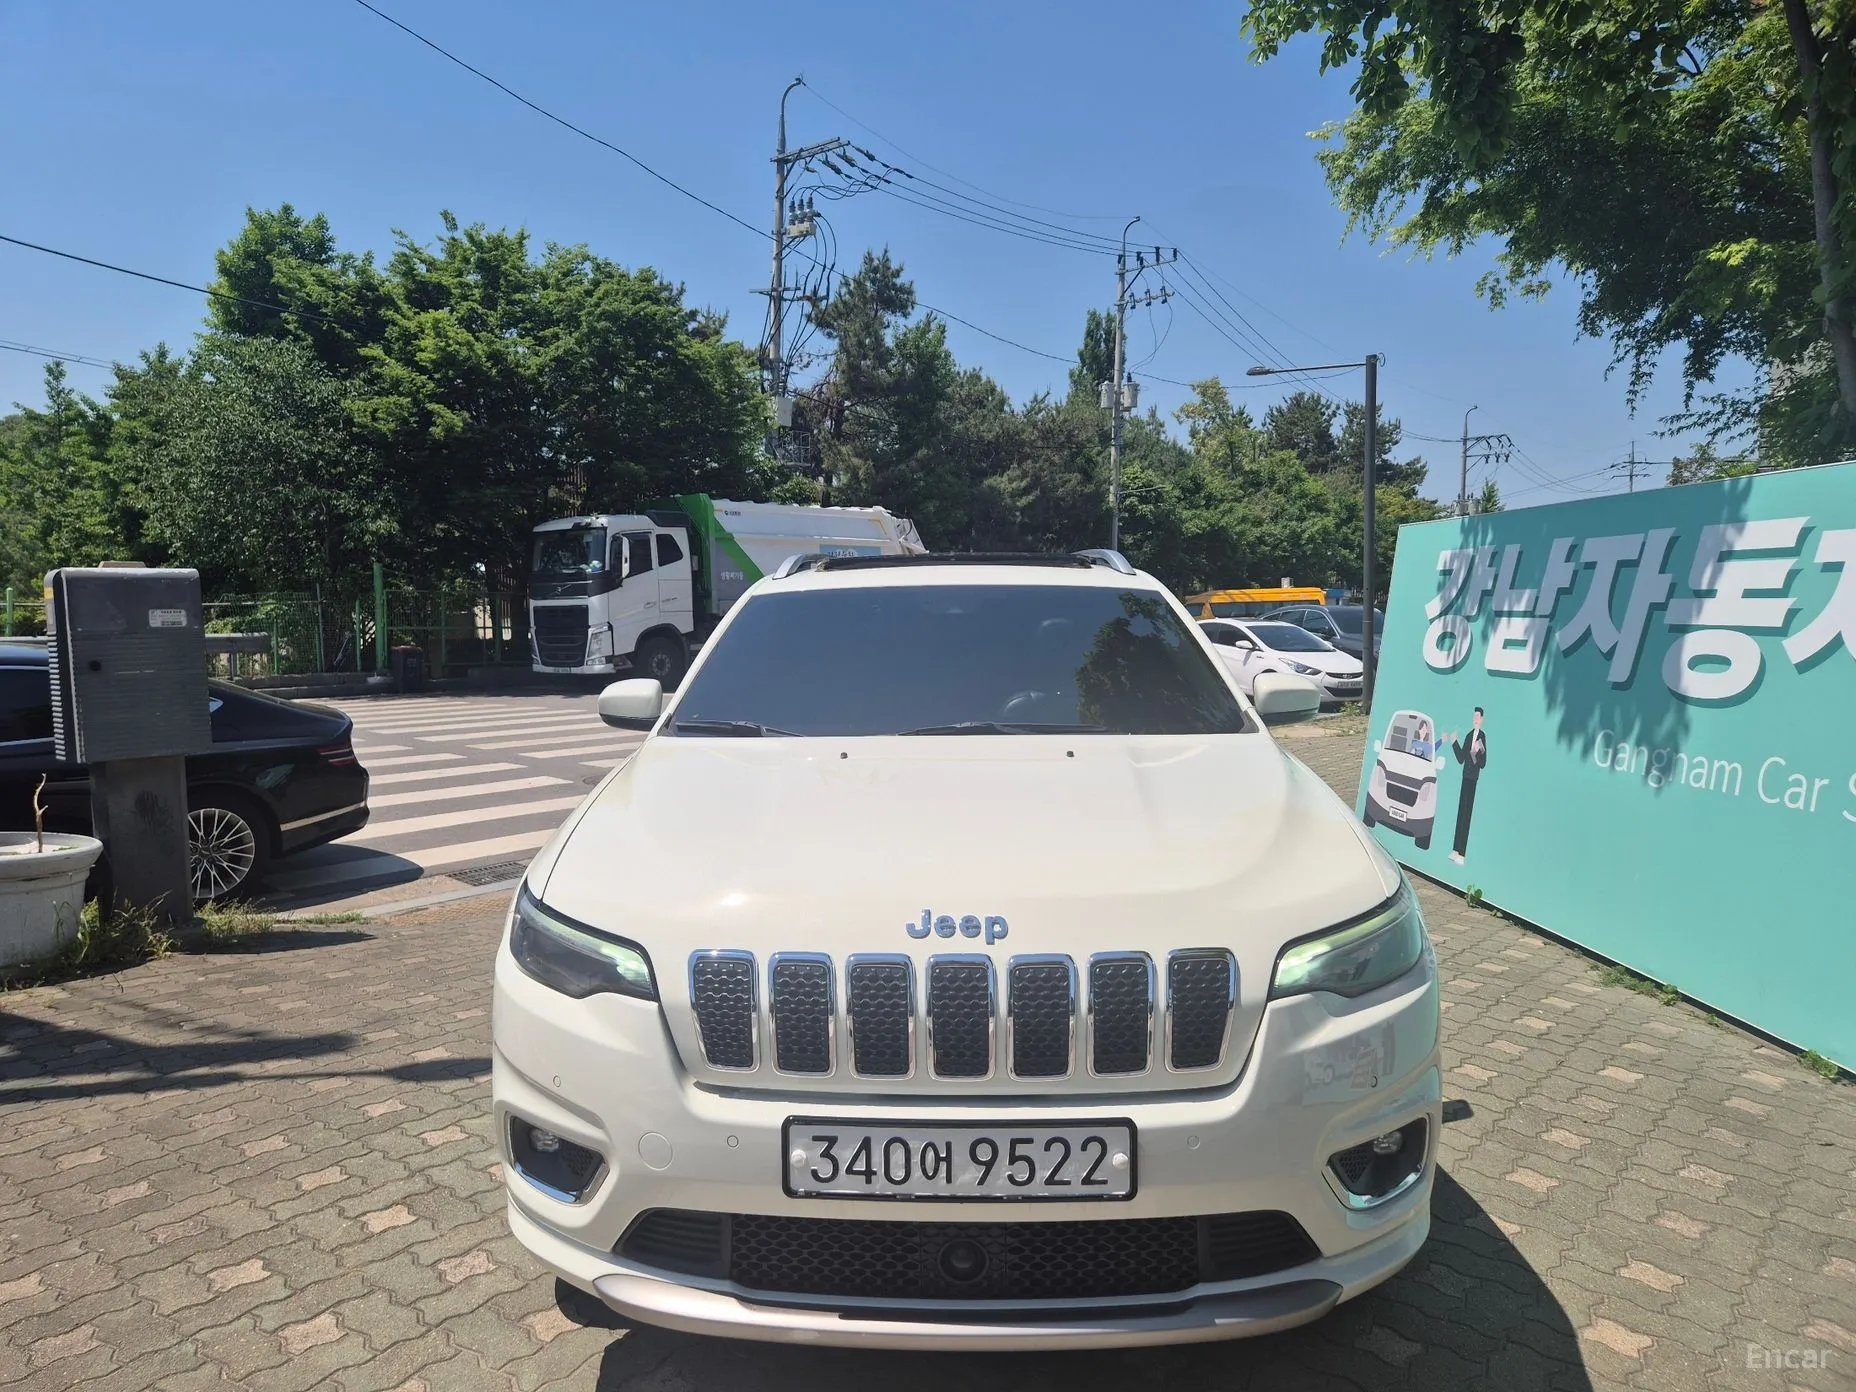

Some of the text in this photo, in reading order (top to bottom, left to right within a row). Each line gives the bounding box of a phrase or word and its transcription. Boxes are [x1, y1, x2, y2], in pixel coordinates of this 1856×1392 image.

[1594, 728, 1743, 796] Gangnam
[1757, 756, 1830, 812] Car
[905, 908, 1009, 946] Jeep
